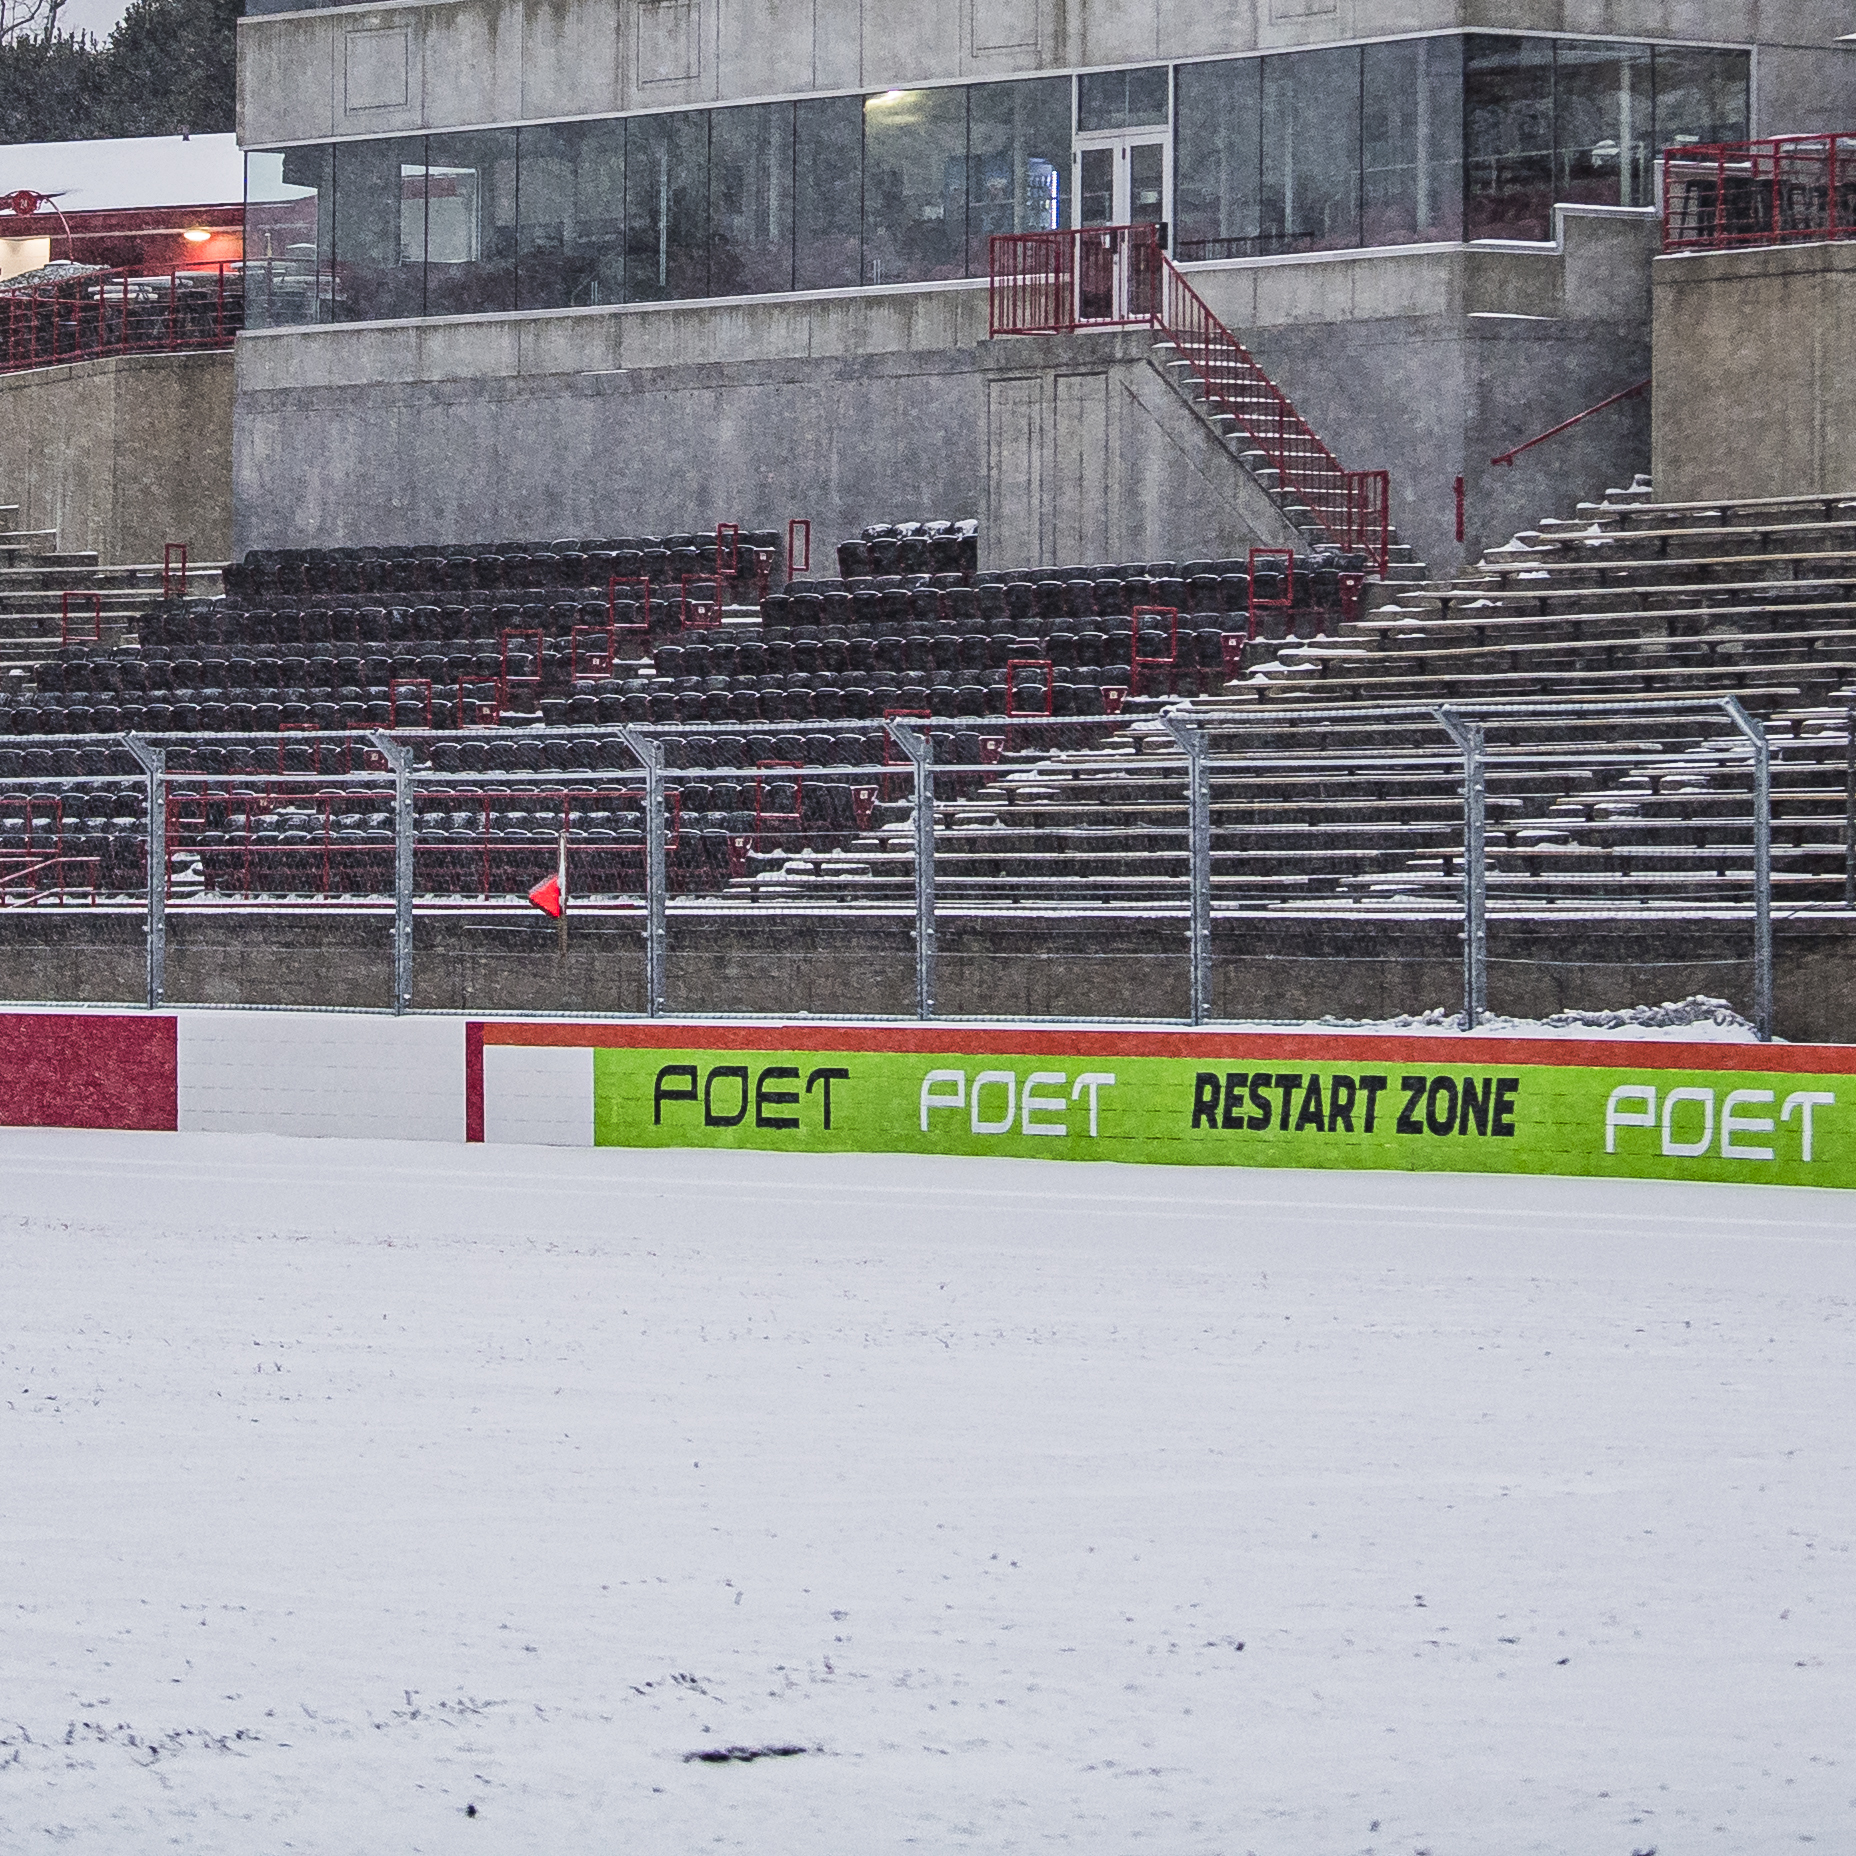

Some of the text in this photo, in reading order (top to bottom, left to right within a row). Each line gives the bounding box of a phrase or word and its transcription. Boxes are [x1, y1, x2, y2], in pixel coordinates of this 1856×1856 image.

[653, 1064, 850, 1131] POET
[920, 1068, 1116, 1138] POET
[1191, 1070, 1520, 1138] RESTART ZONE
[1604, 1084, 1836, 1163] POET
